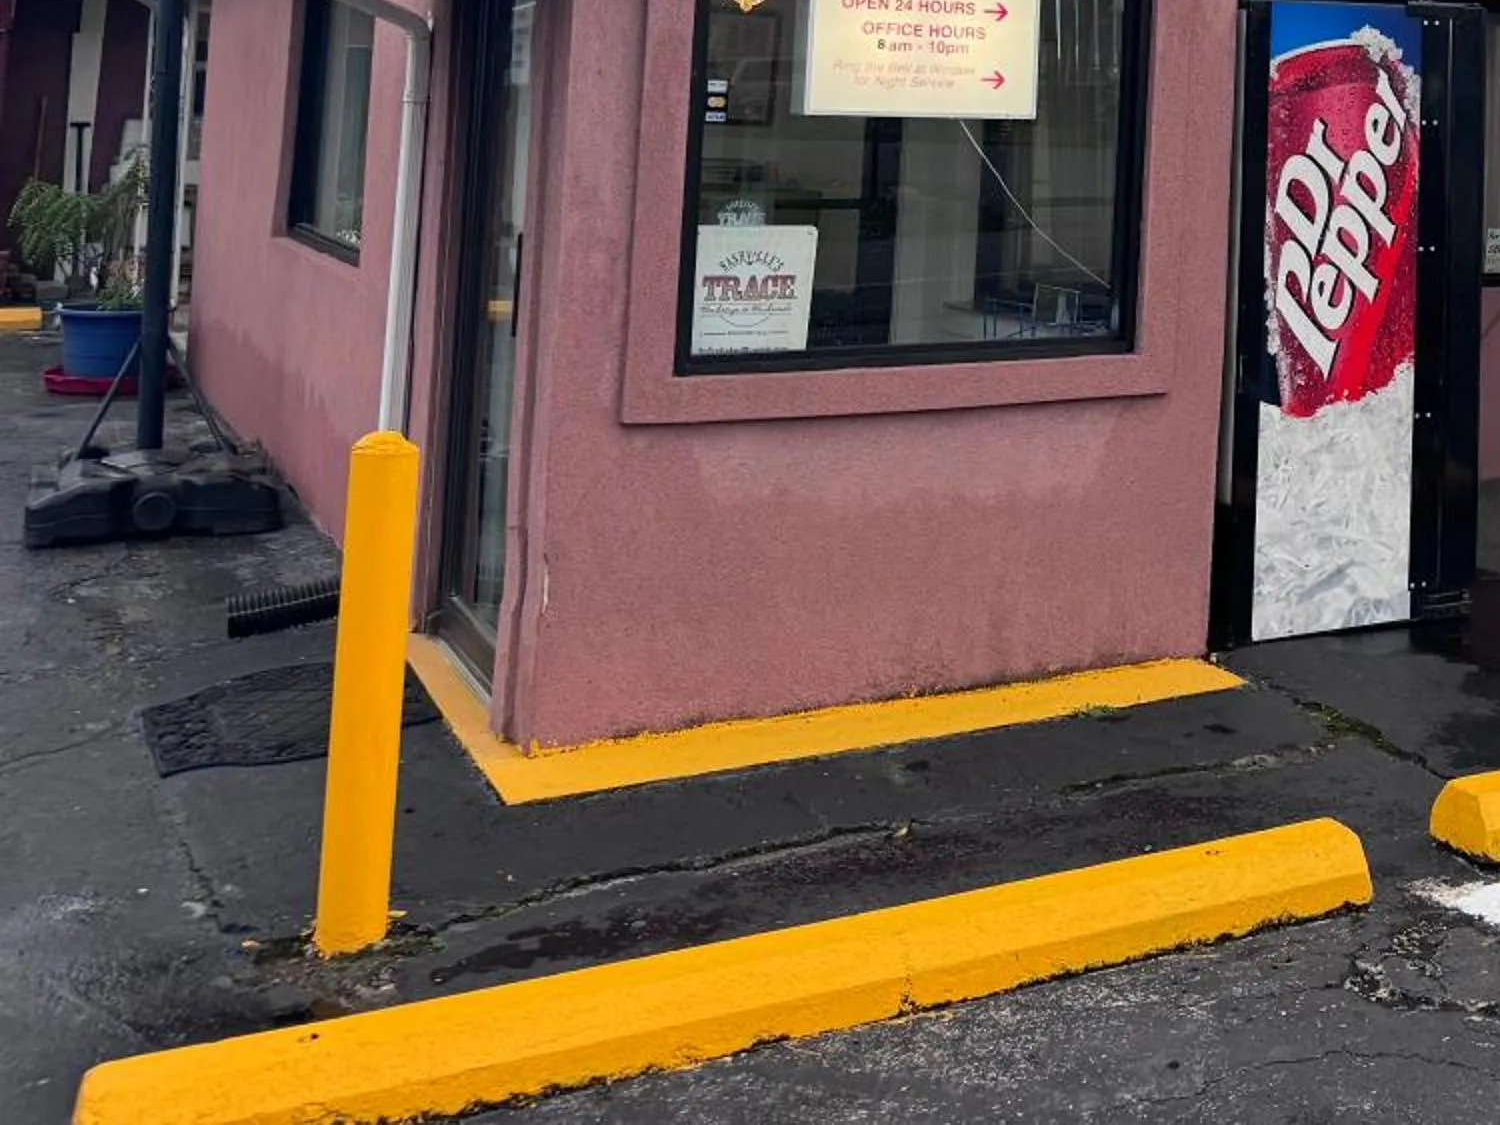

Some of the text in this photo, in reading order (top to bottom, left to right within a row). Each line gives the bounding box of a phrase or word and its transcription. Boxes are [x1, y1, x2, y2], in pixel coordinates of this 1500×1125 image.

[918, 0, 977, 16] HOURS
[862, 20, 987, 40] OFFICE HOURS
[929, 40, 970, 56] 10pm
[1276, 117, 1346, 258] Dr
[1276, 66, 1407, 380] Pepper
[702, 274, 798, 302] TRACE
